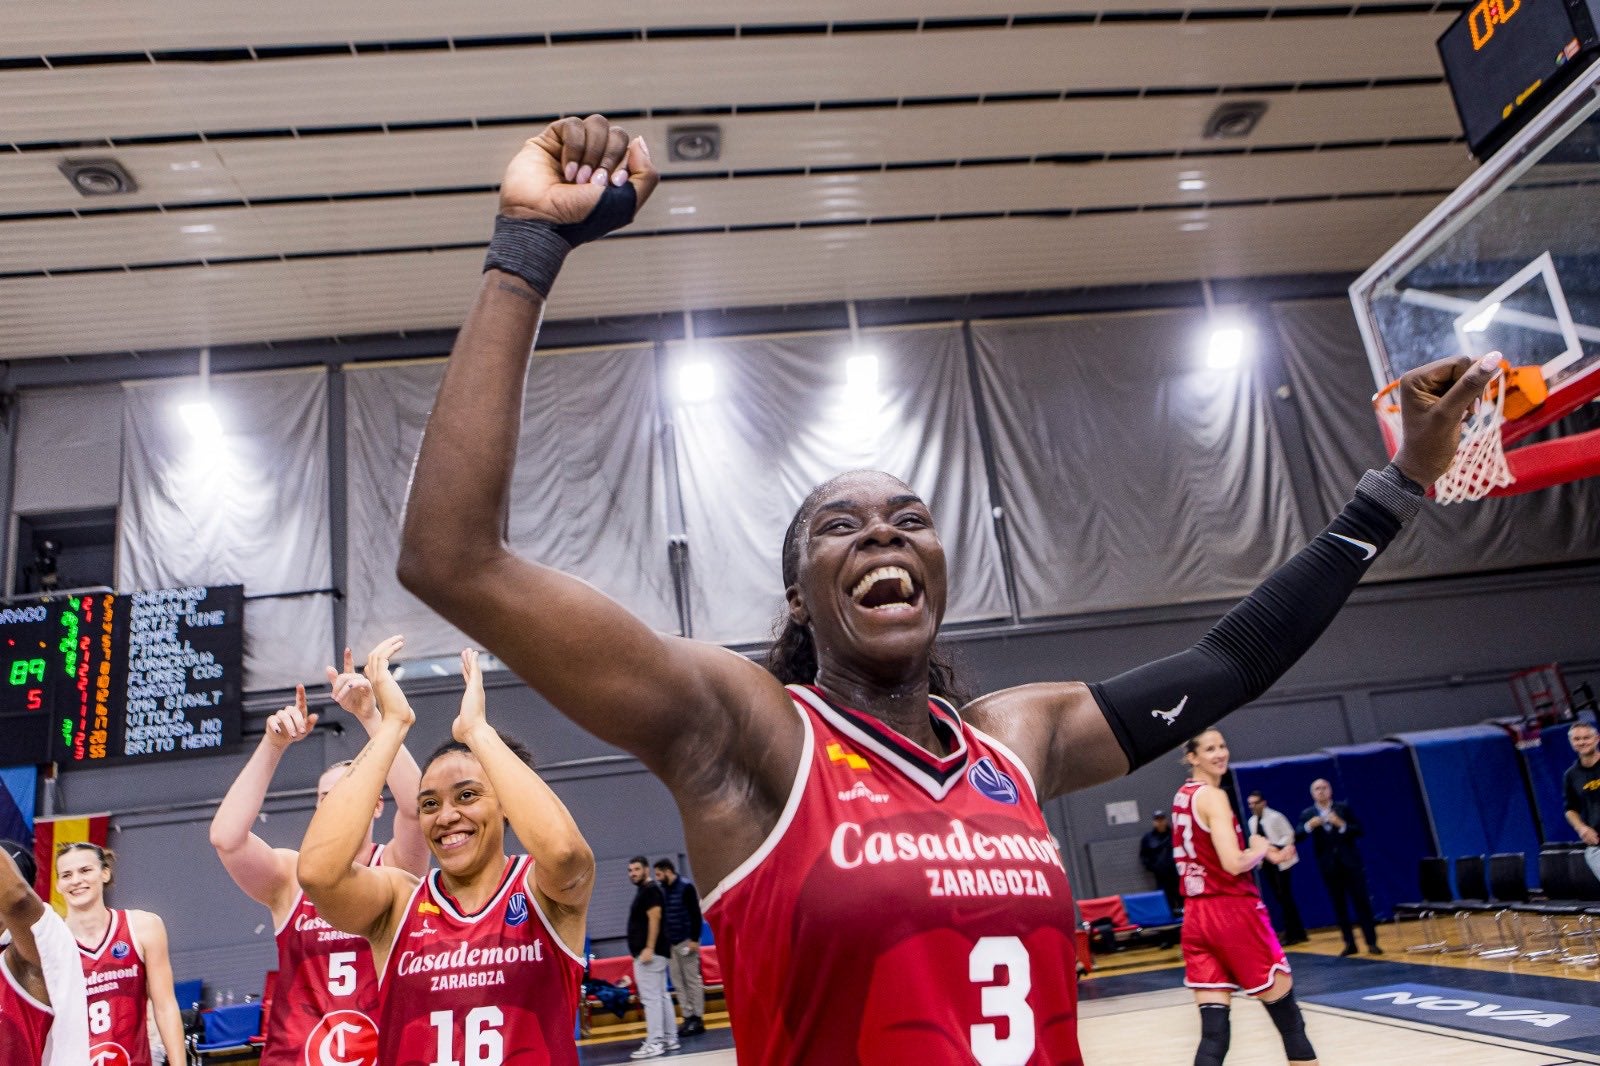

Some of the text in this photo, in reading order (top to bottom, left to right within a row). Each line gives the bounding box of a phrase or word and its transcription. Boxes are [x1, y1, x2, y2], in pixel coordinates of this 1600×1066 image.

[9, 658, 46, 686] 89
[26, 688, 43, 710] 5
[831, 819, 1065, 870] Casademon
[926, 869, 1052, 897] ZARAGOZA
[327, 951, 357, 997] 5
[397, 938, 544, 977] Casademont
[430, 970, 505, 992] ZARAGOZA
[88, 1000, 112, 1035] 8
[968, 935, 1036, 1066] 3
[1362, 991, 1572, 1029] NOVA
[430, 1005, 505, 1066] 16
